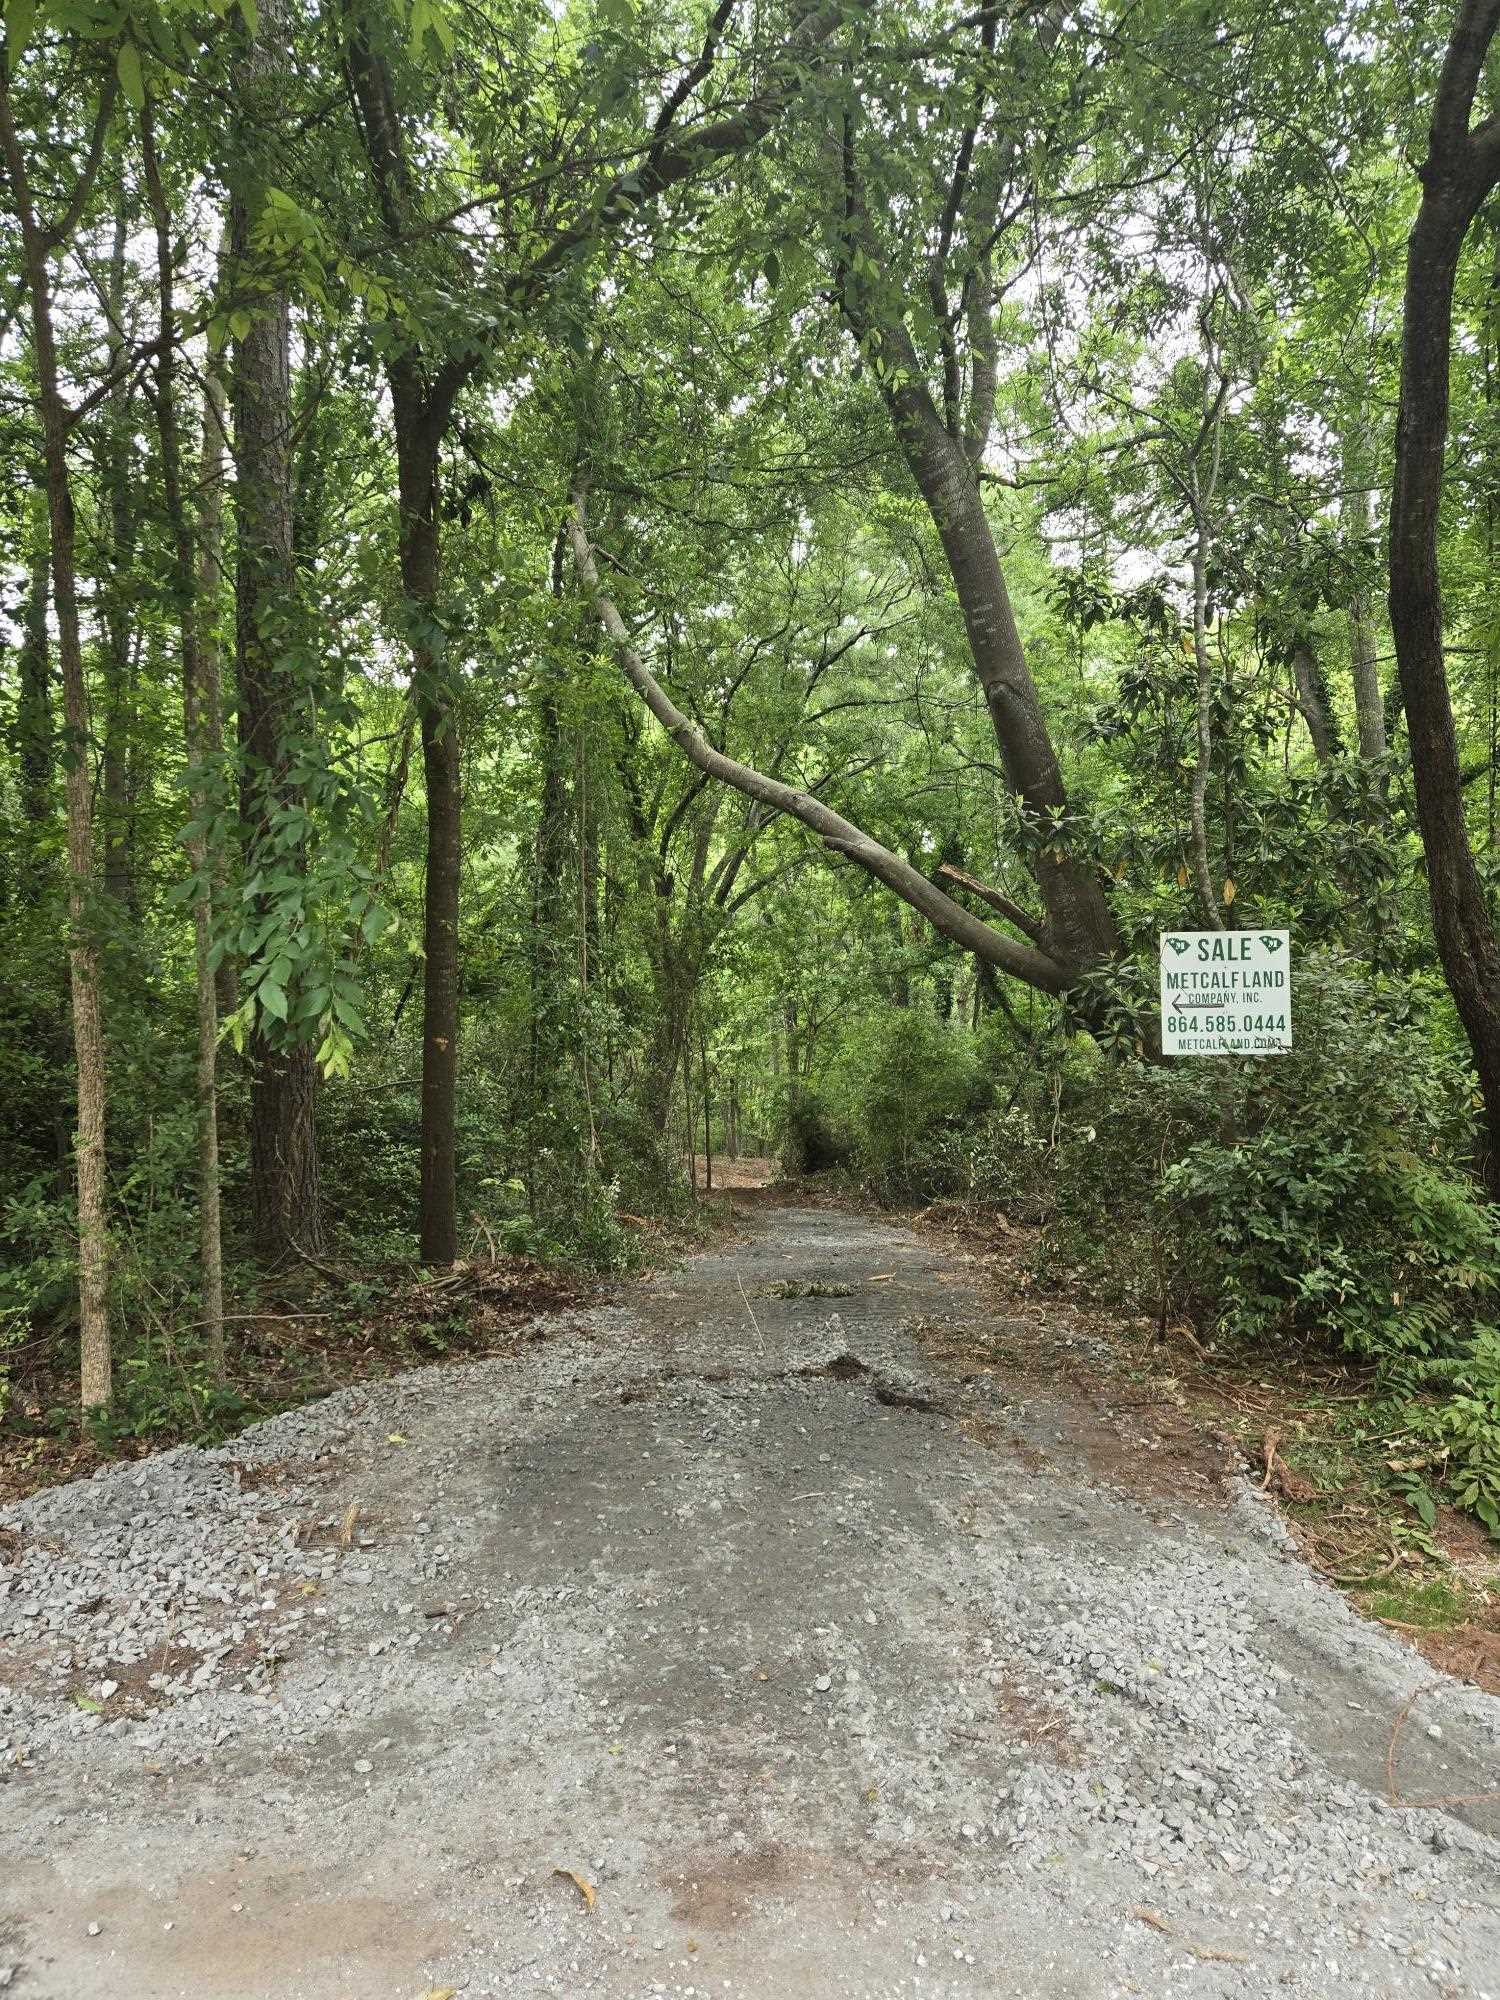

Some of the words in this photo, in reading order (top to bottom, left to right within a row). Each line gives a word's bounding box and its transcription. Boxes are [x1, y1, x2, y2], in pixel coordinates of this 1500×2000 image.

[1197, 937, 1252, 962] SALE
[1166, 971, 1239, 989] METCALF
[1242, 970, 1285, 988] LAND
[1188, 992, 1239, 1004] COMPANY,
[1242, 992, 1262, 1003] INC.
[1167, 1015, 1286, 1033] 864.585.0444
[1178, 1038, 1279, 1050] METCALFAND.COM
